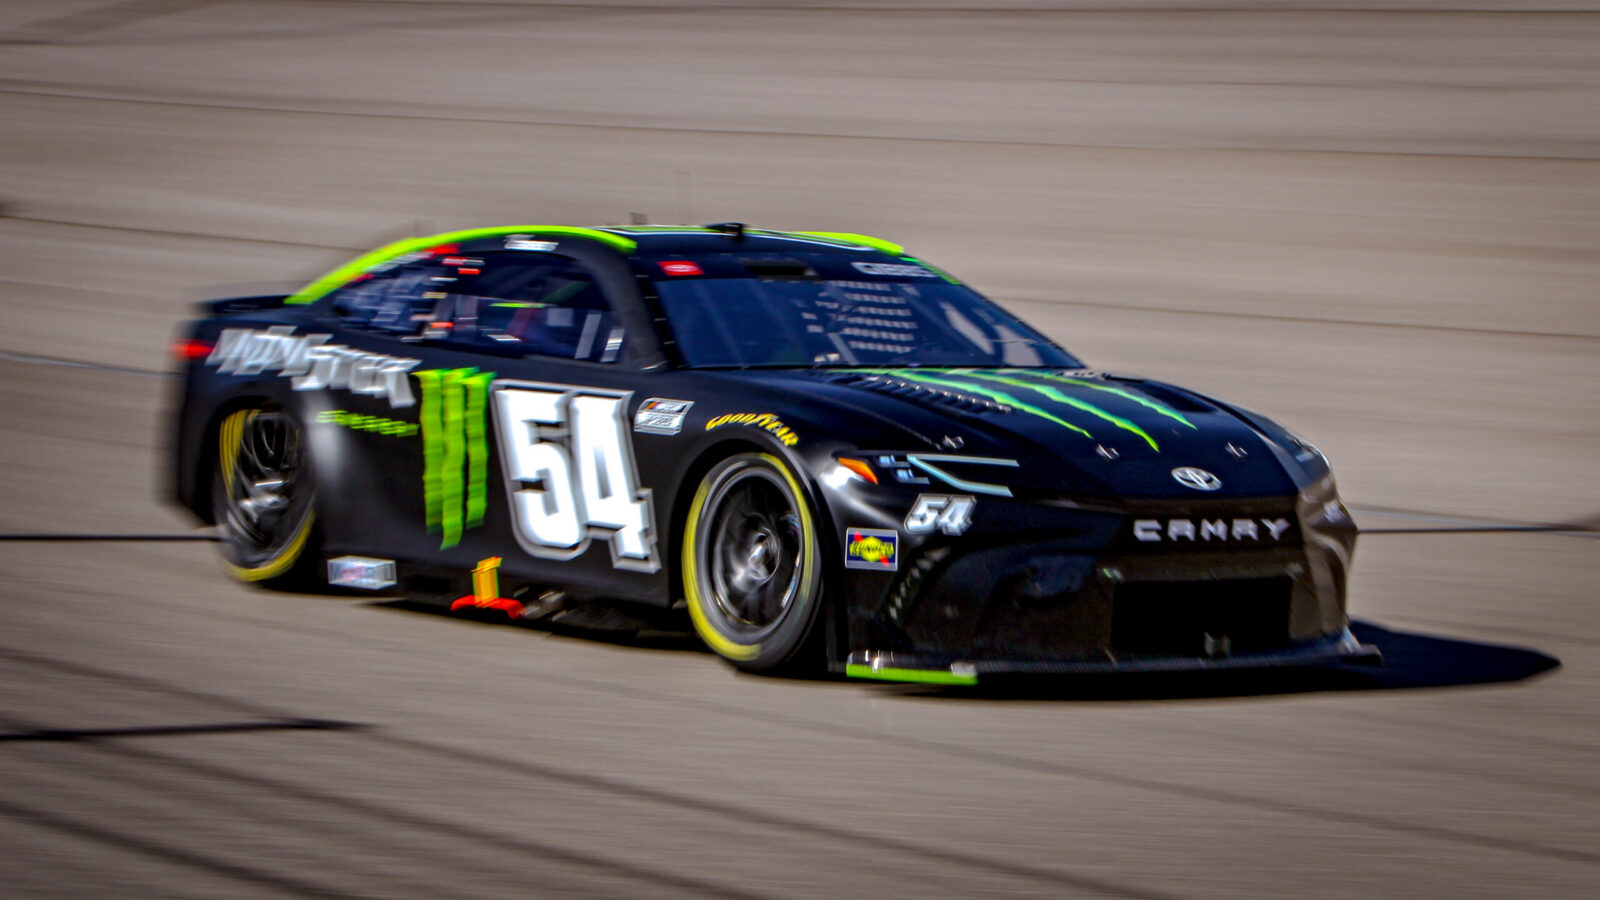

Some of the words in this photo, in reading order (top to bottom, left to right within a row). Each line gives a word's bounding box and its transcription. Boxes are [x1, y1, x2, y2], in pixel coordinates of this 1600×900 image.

[705, 412, 799, 446] GOODYEAR
[490, 380, 661, 574] 54
[905, 493, 977, 535] 54
[1133, 518, 1290, 541] CAMRY
